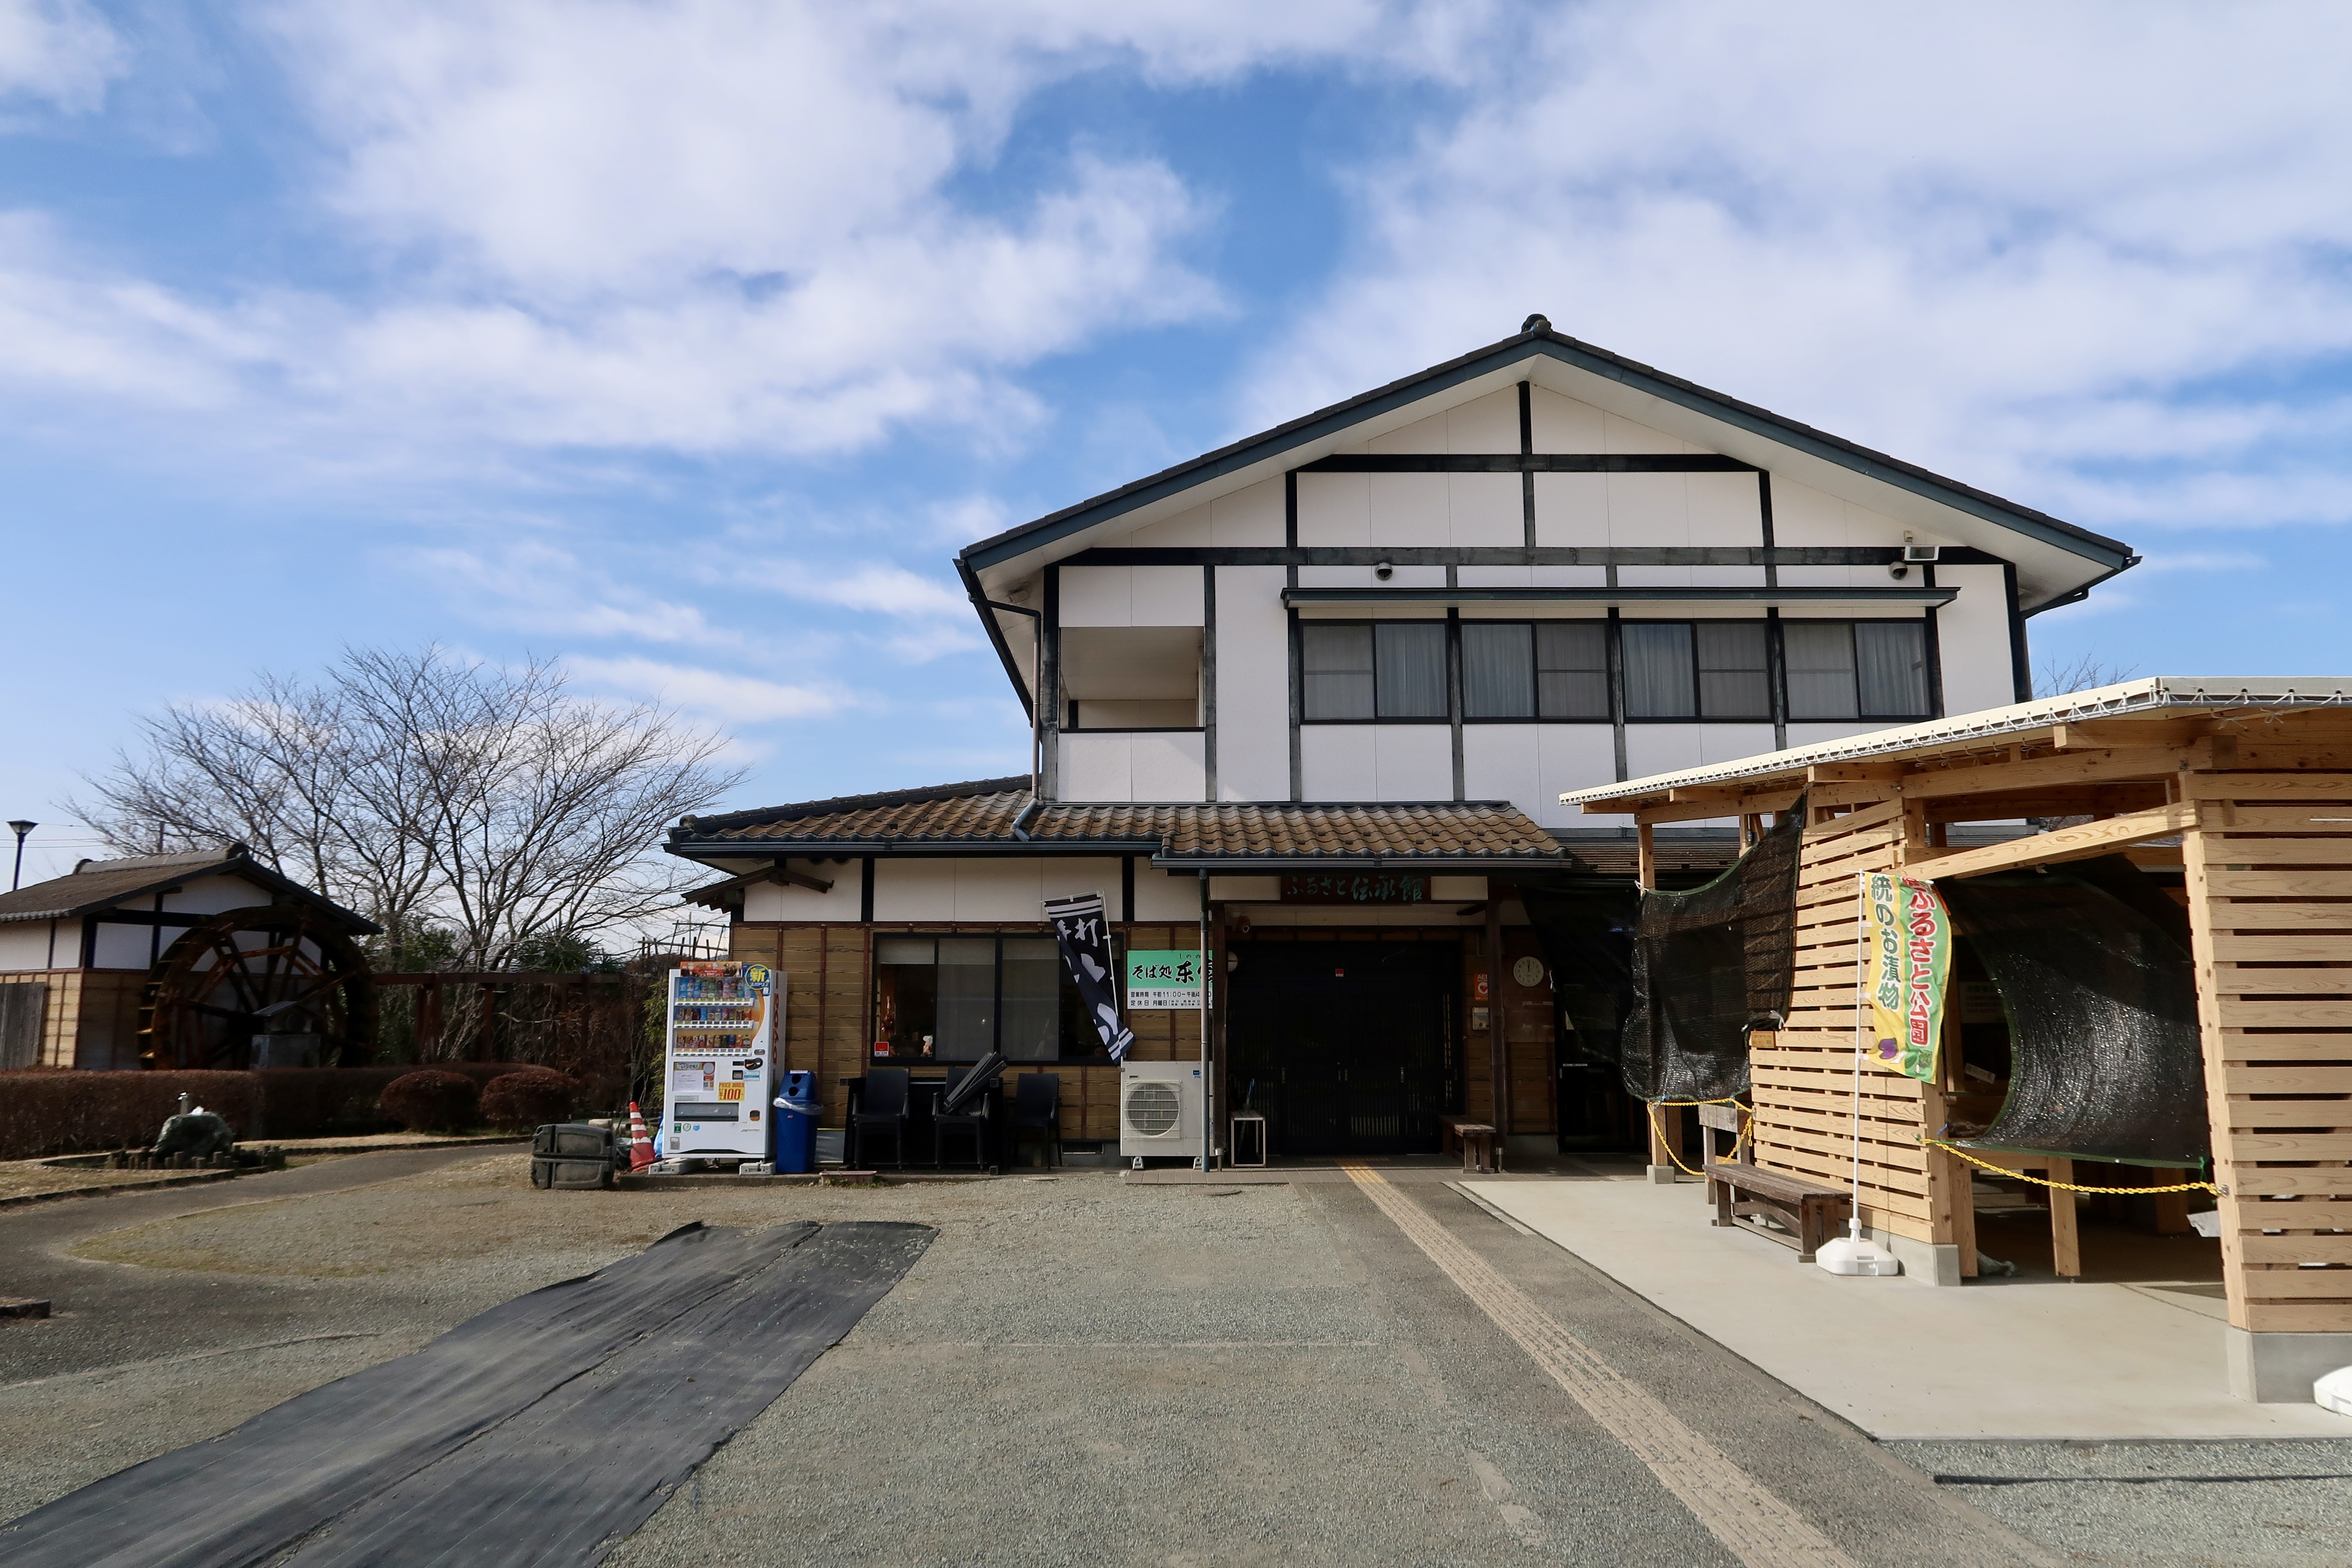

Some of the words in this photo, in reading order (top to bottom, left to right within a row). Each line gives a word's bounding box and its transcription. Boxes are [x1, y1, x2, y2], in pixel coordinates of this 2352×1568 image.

[1287, 876, 1424, 901] ふるさと伝承館
[750, 968, 766, 982] 新
